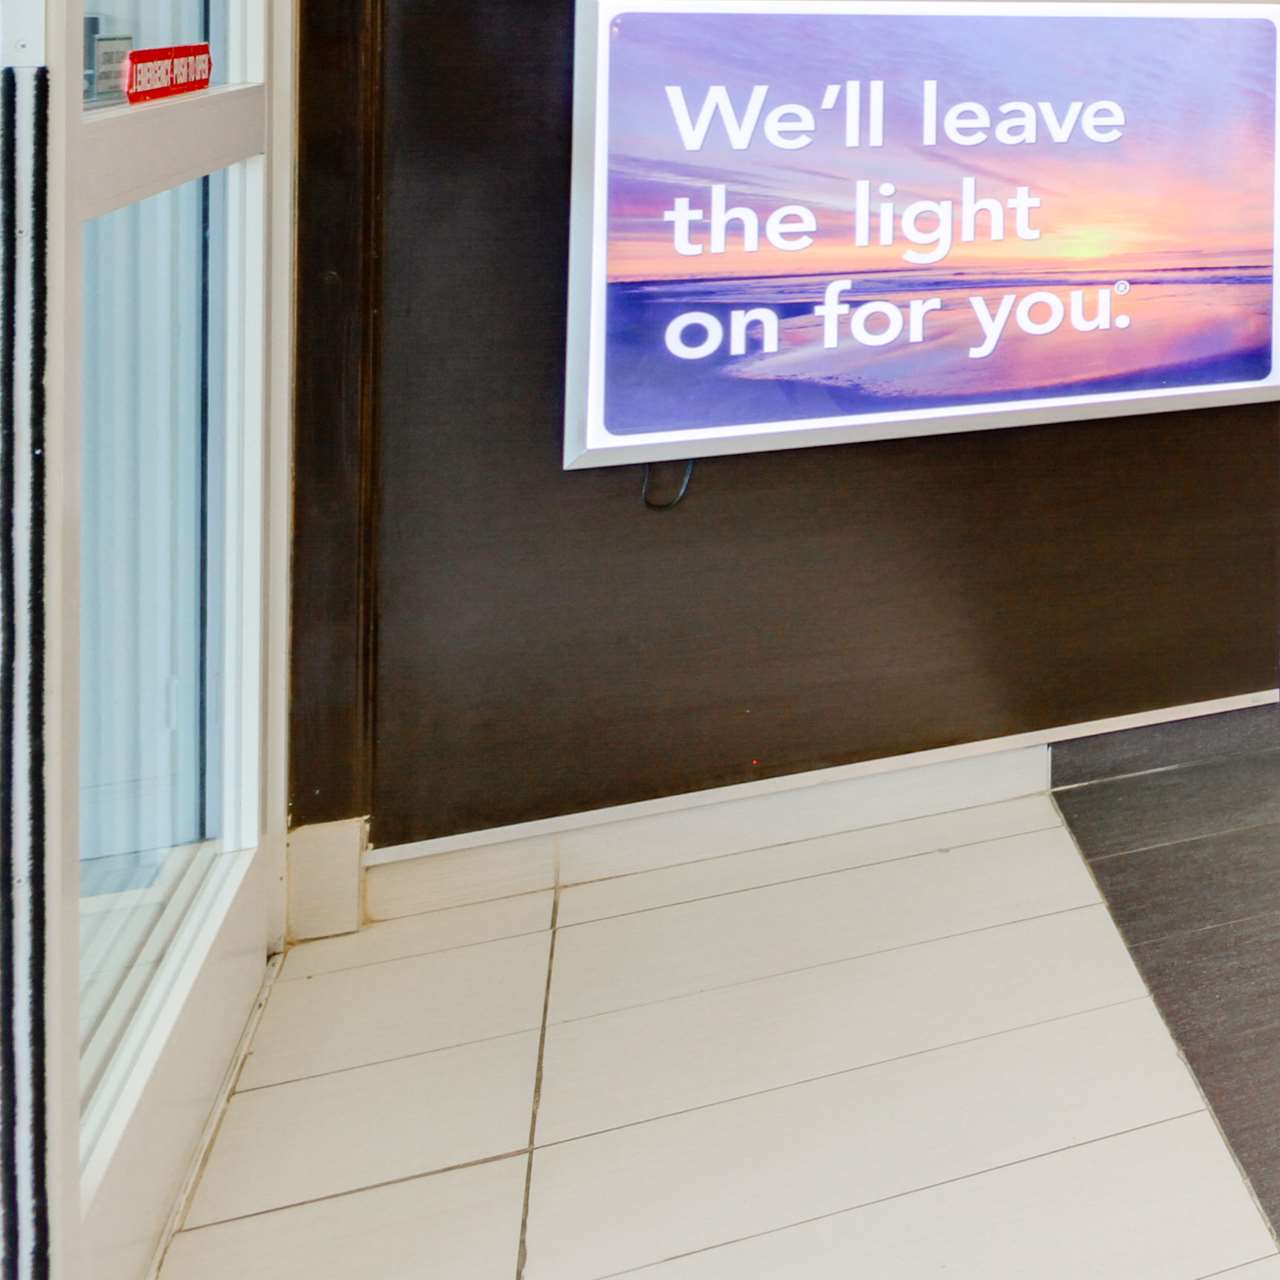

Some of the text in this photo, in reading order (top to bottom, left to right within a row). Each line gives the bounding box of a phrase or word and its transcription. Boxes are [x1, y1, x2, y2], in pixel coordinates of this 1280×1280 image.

[663, 79, 1126, 151] We'll leave
[663, 176, 1041, 265] the light
[664, 304, 780, 360] on
[813, 279, 941, 349] for
